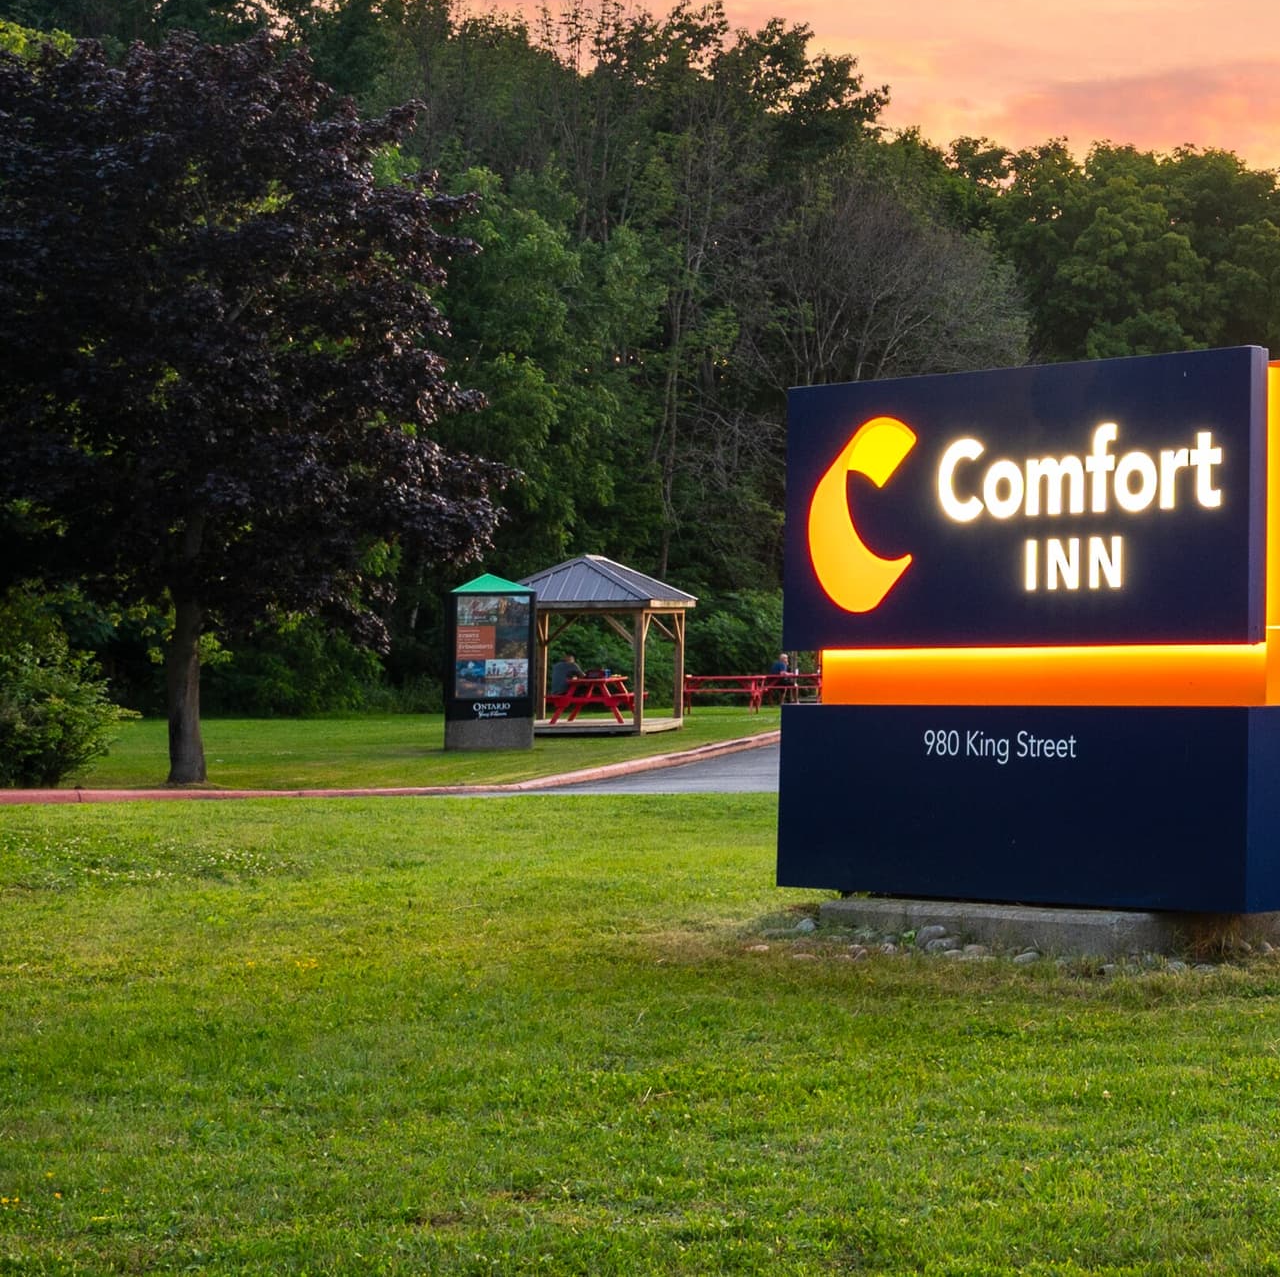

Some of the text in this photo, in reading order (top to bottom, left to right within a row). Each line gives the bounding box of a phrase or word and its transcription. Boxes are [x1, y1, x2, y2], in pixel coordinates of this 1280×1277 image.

[937, 422, 1223, 522] Comfort
[1024, 535, 1123, 591] INN
[924, 729, 1077, 765] 980 King Street
